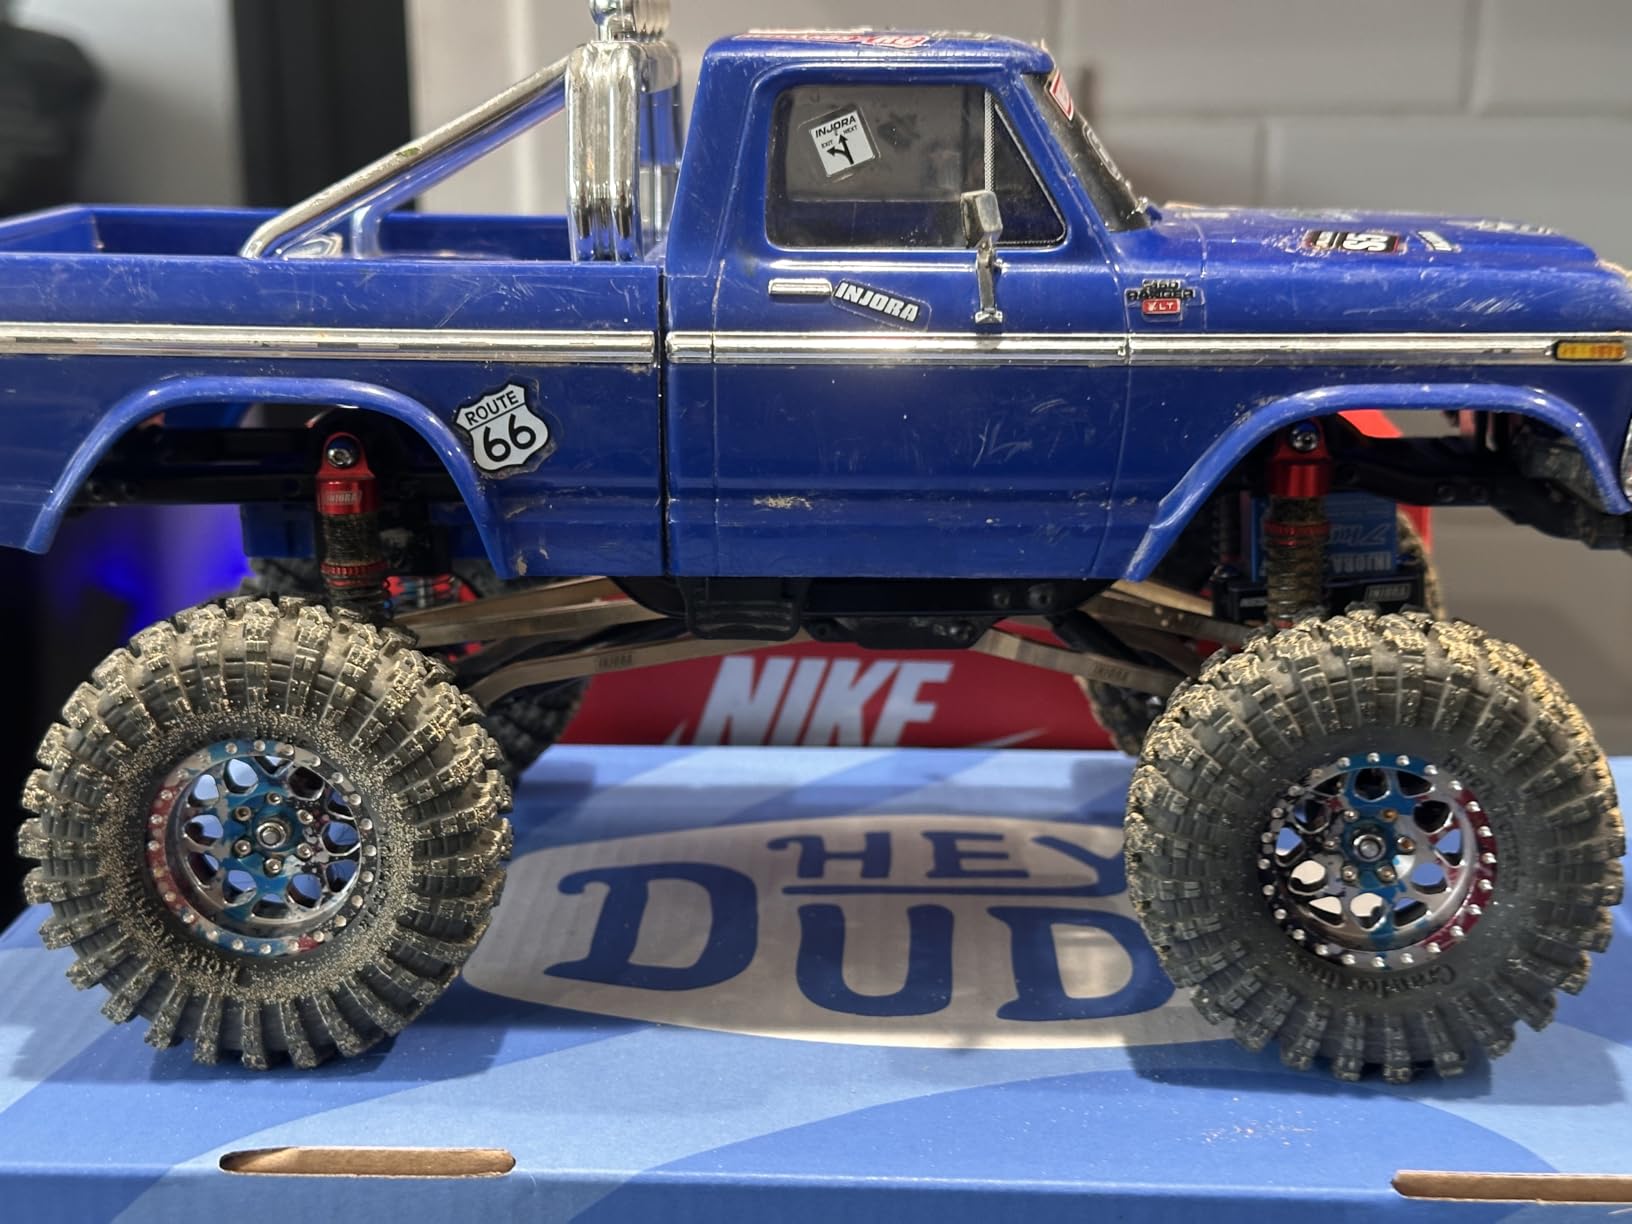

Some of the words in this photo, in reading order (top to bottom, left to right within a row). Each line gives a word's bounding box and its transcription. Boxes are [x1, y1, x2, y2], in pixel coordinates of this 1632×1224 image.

[815, 115, 856, 138] INJORA
[835, 282, 919, 322] INJORA
[1147, 302, 1174, 312] XLT
[464, 390, 519, 426] ROUTE
[483, 412, 537, 463] 66
[543, 861, 1177, 1022] DUD
